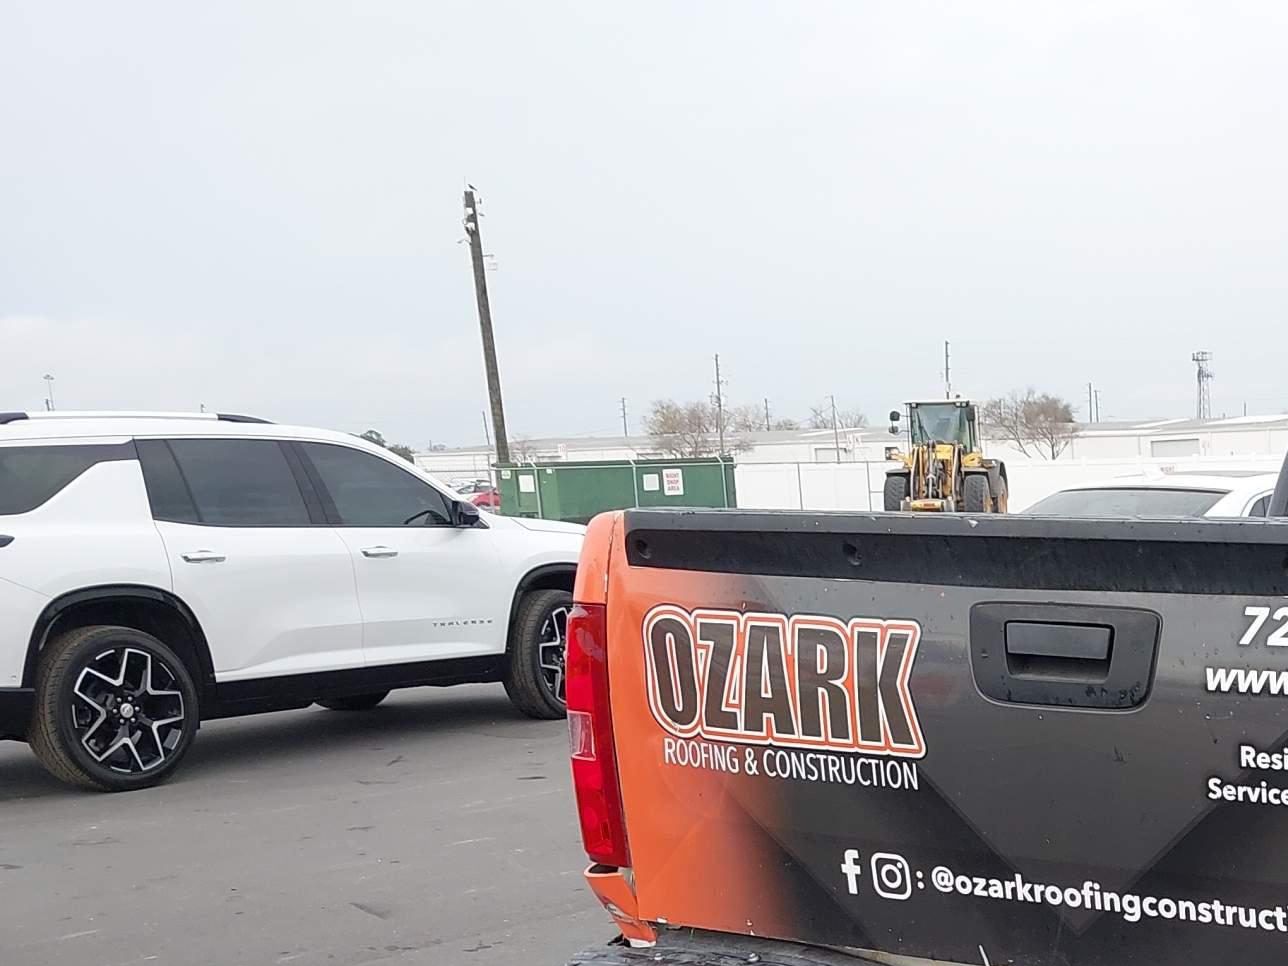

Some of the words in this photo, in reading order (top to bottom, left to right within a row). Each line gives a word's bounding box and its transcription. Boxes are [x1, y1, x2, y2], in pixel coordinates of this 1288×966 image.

[643, 604, 927, 758] OZARK
[664, 738, 740, 773] ROOFING
[743, 749, 760, 776] &
[762, 749, 920, 791] CONSTRUCTION
